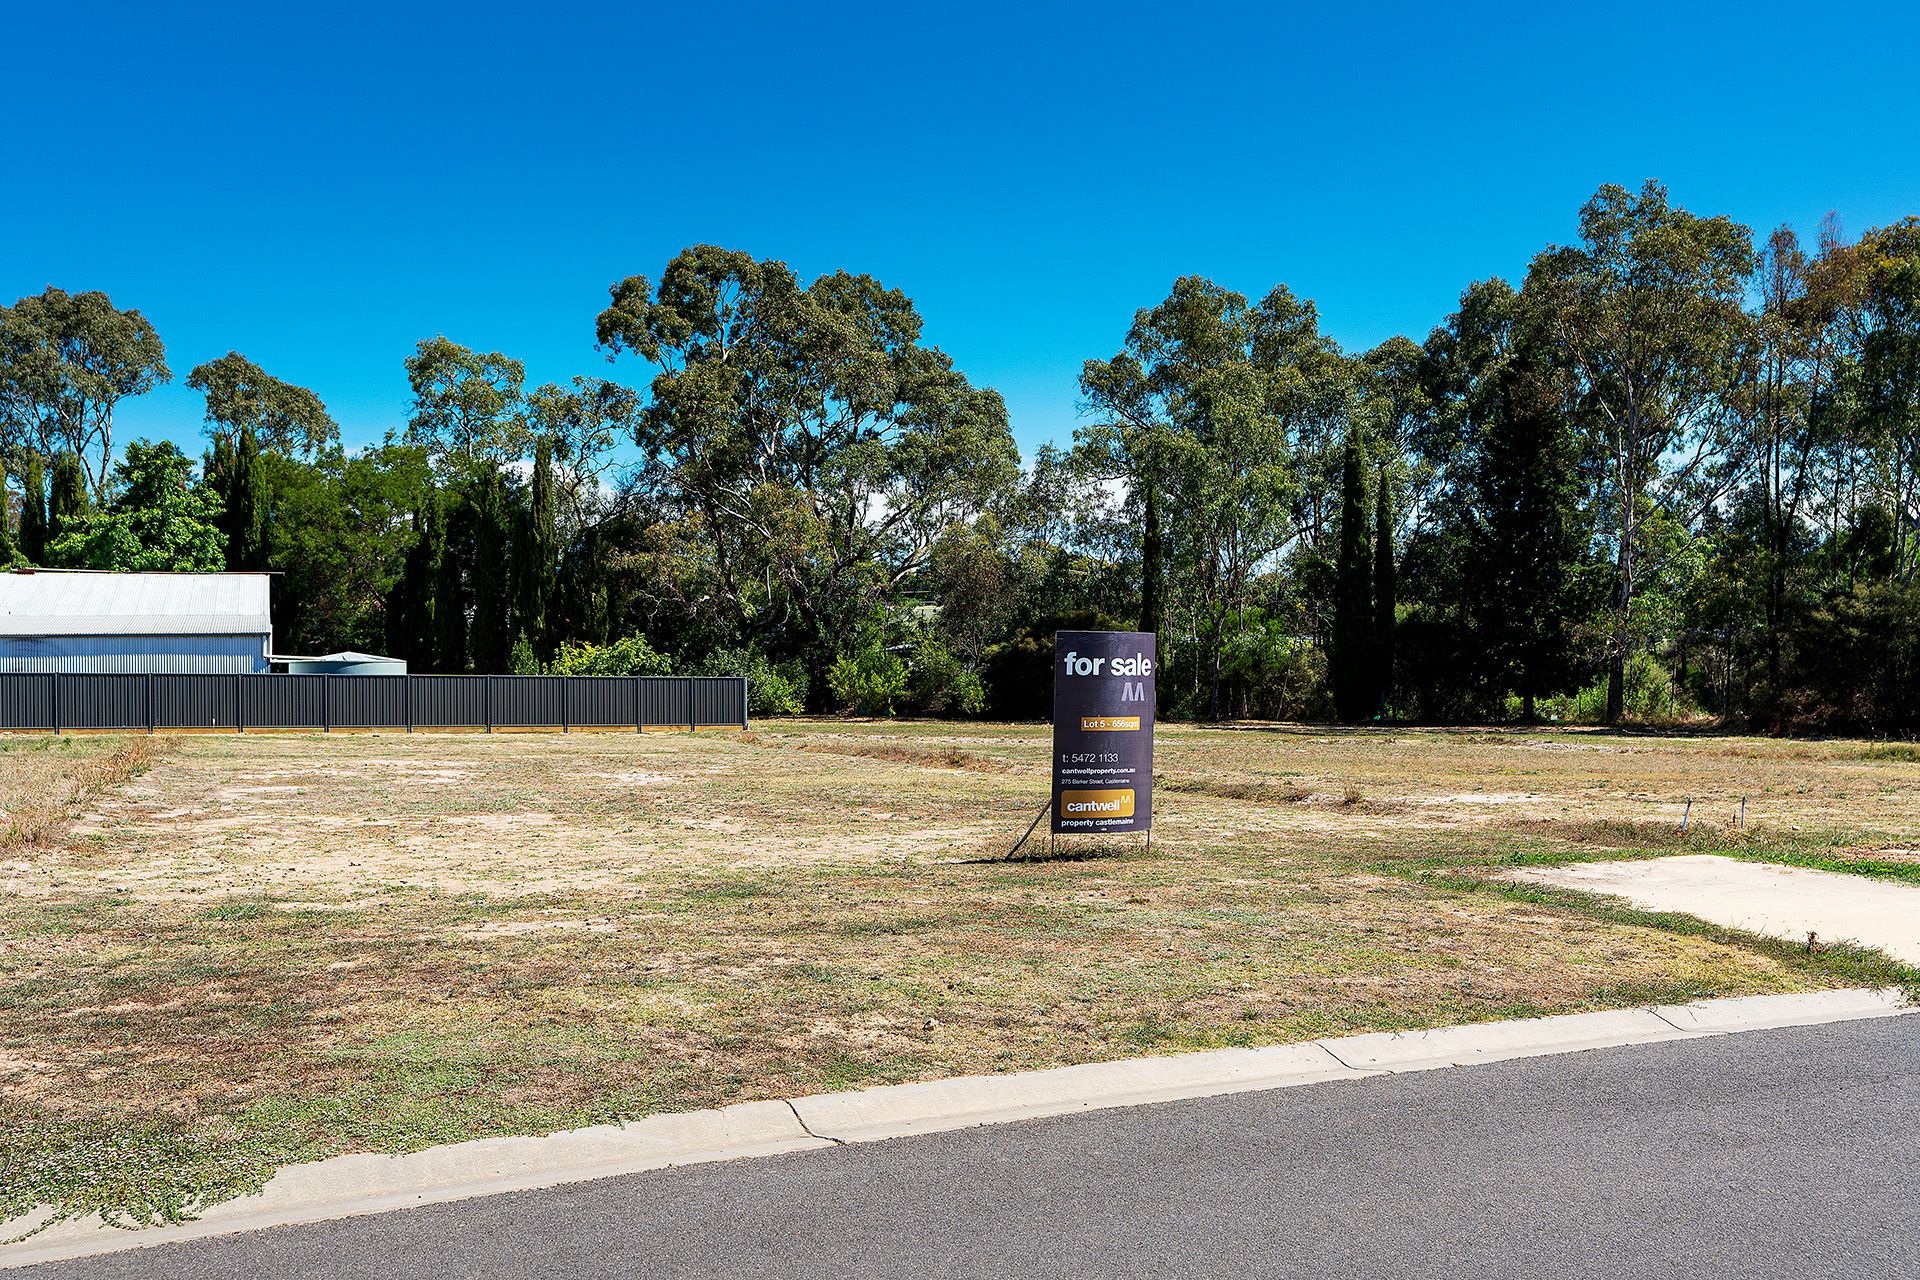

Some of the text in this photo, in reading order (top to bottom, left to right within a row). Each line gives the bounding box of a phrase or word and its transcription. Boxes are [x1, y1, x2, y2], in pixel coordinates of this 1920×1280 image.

[1064, 651, 1152, 677] for sale
[1083, 720, 1099, 728] Lot
[1099, 720, 1106, 728] 5
[1062, 753, 1119, 763] t: 5472 1133
[1061, 767, 1136, 775] cantwellproperty.com.au
[1067, 799, 1120, 812] cantwell
[1061, 817, 1135, 828] property castlemaine
